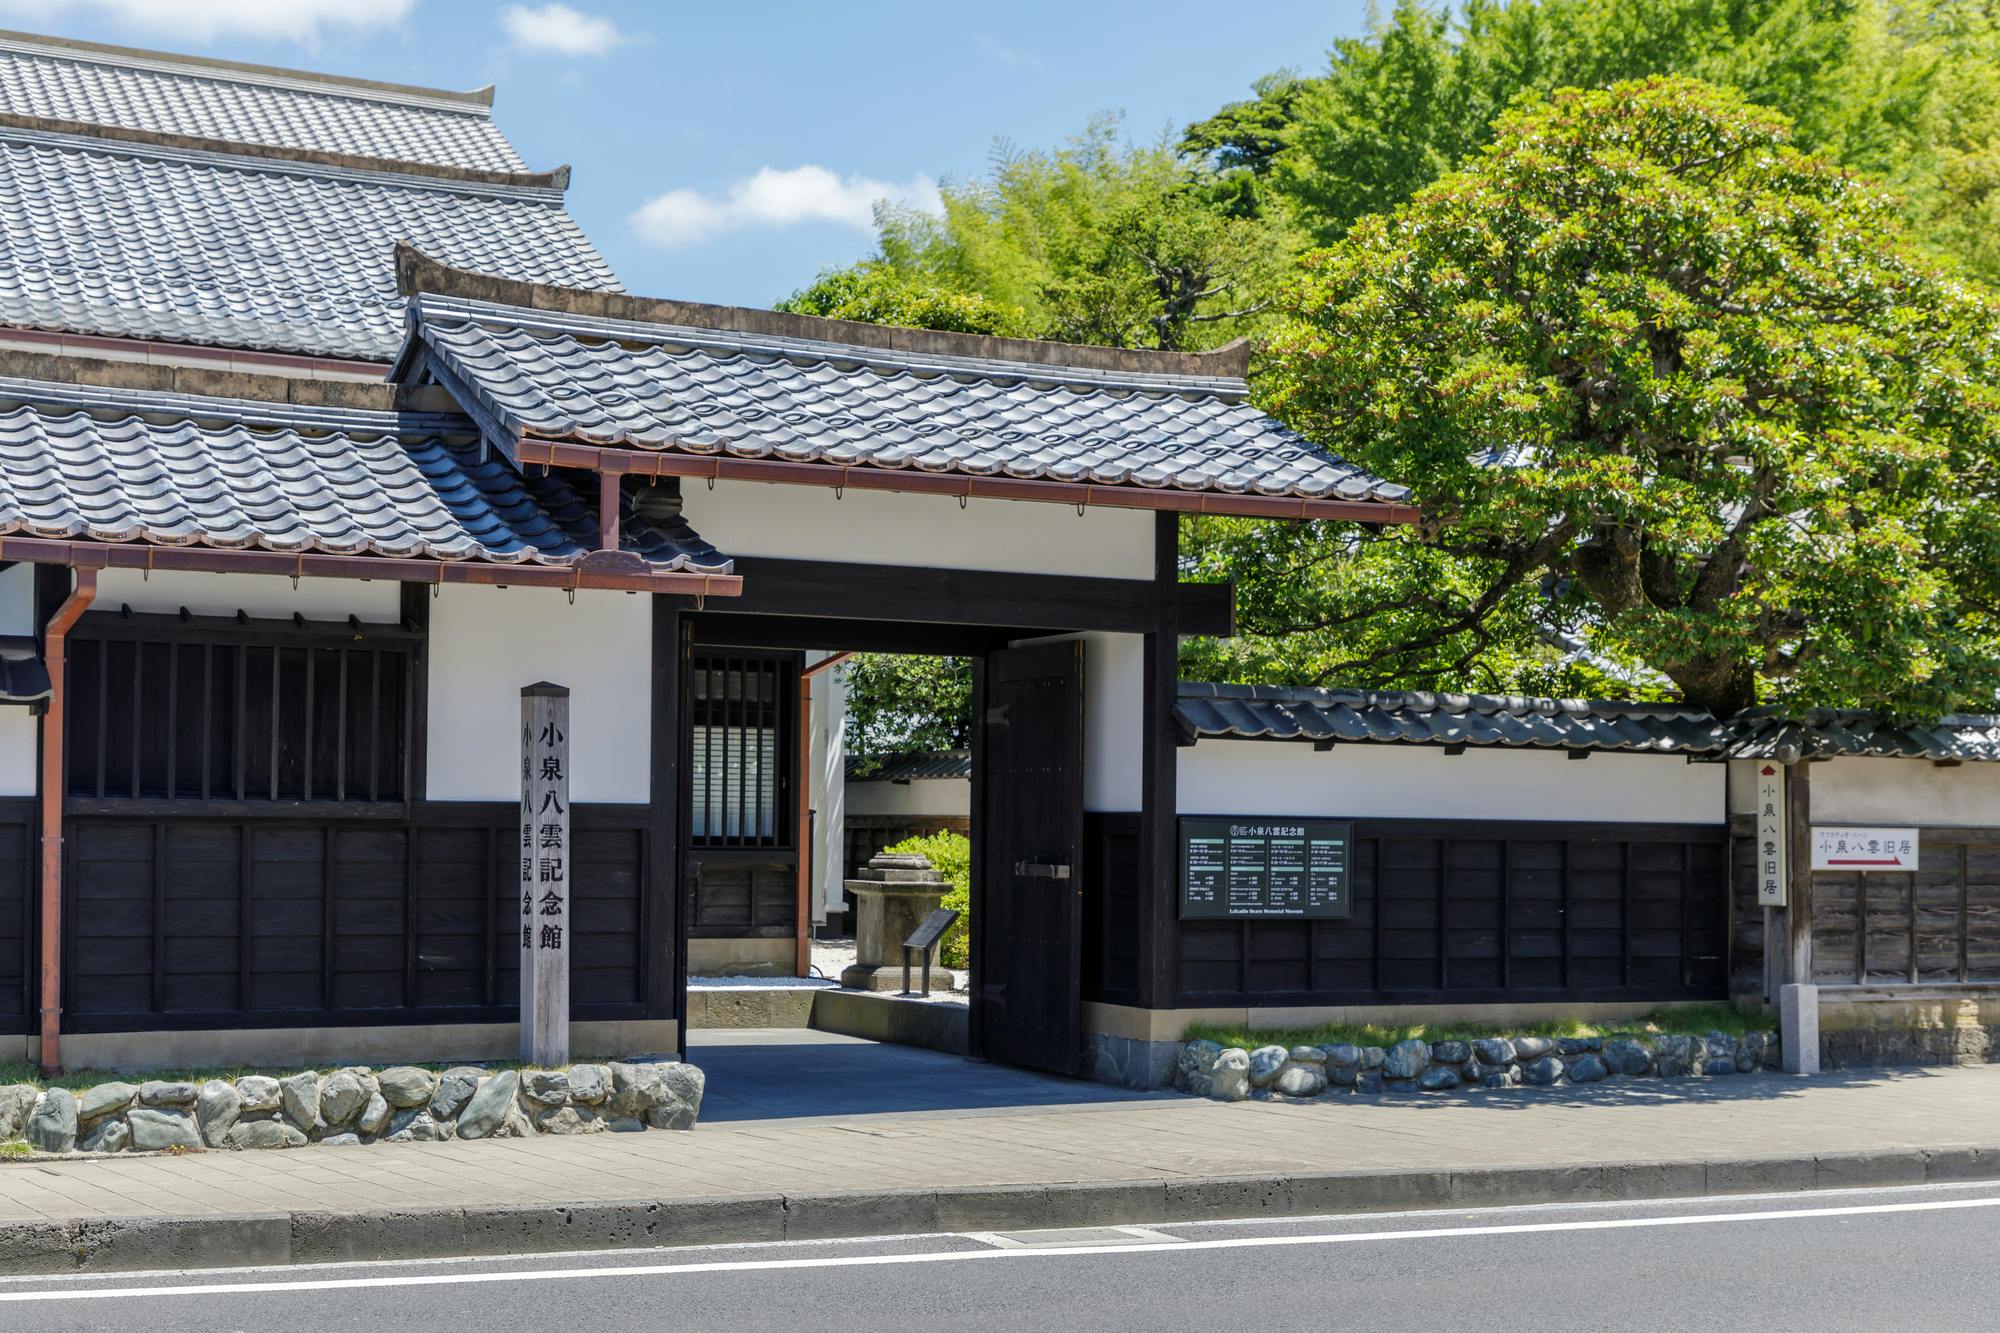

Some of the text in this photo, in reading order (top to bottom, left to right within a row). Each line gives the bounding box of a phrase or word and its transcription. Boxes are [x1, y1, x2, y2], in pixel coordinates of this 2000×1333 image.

[522, 721, 532, 950] 小泉八雲記念館
[538, 721, 564, 950] 小泉八雲記念館
[1248, 826, 1305, 836] 小泉八雲記念館
[1762, 784, 1777, 895] 小泉八雲旧居
[1819, 839, 1911, 854] 小泉八雲旧居
